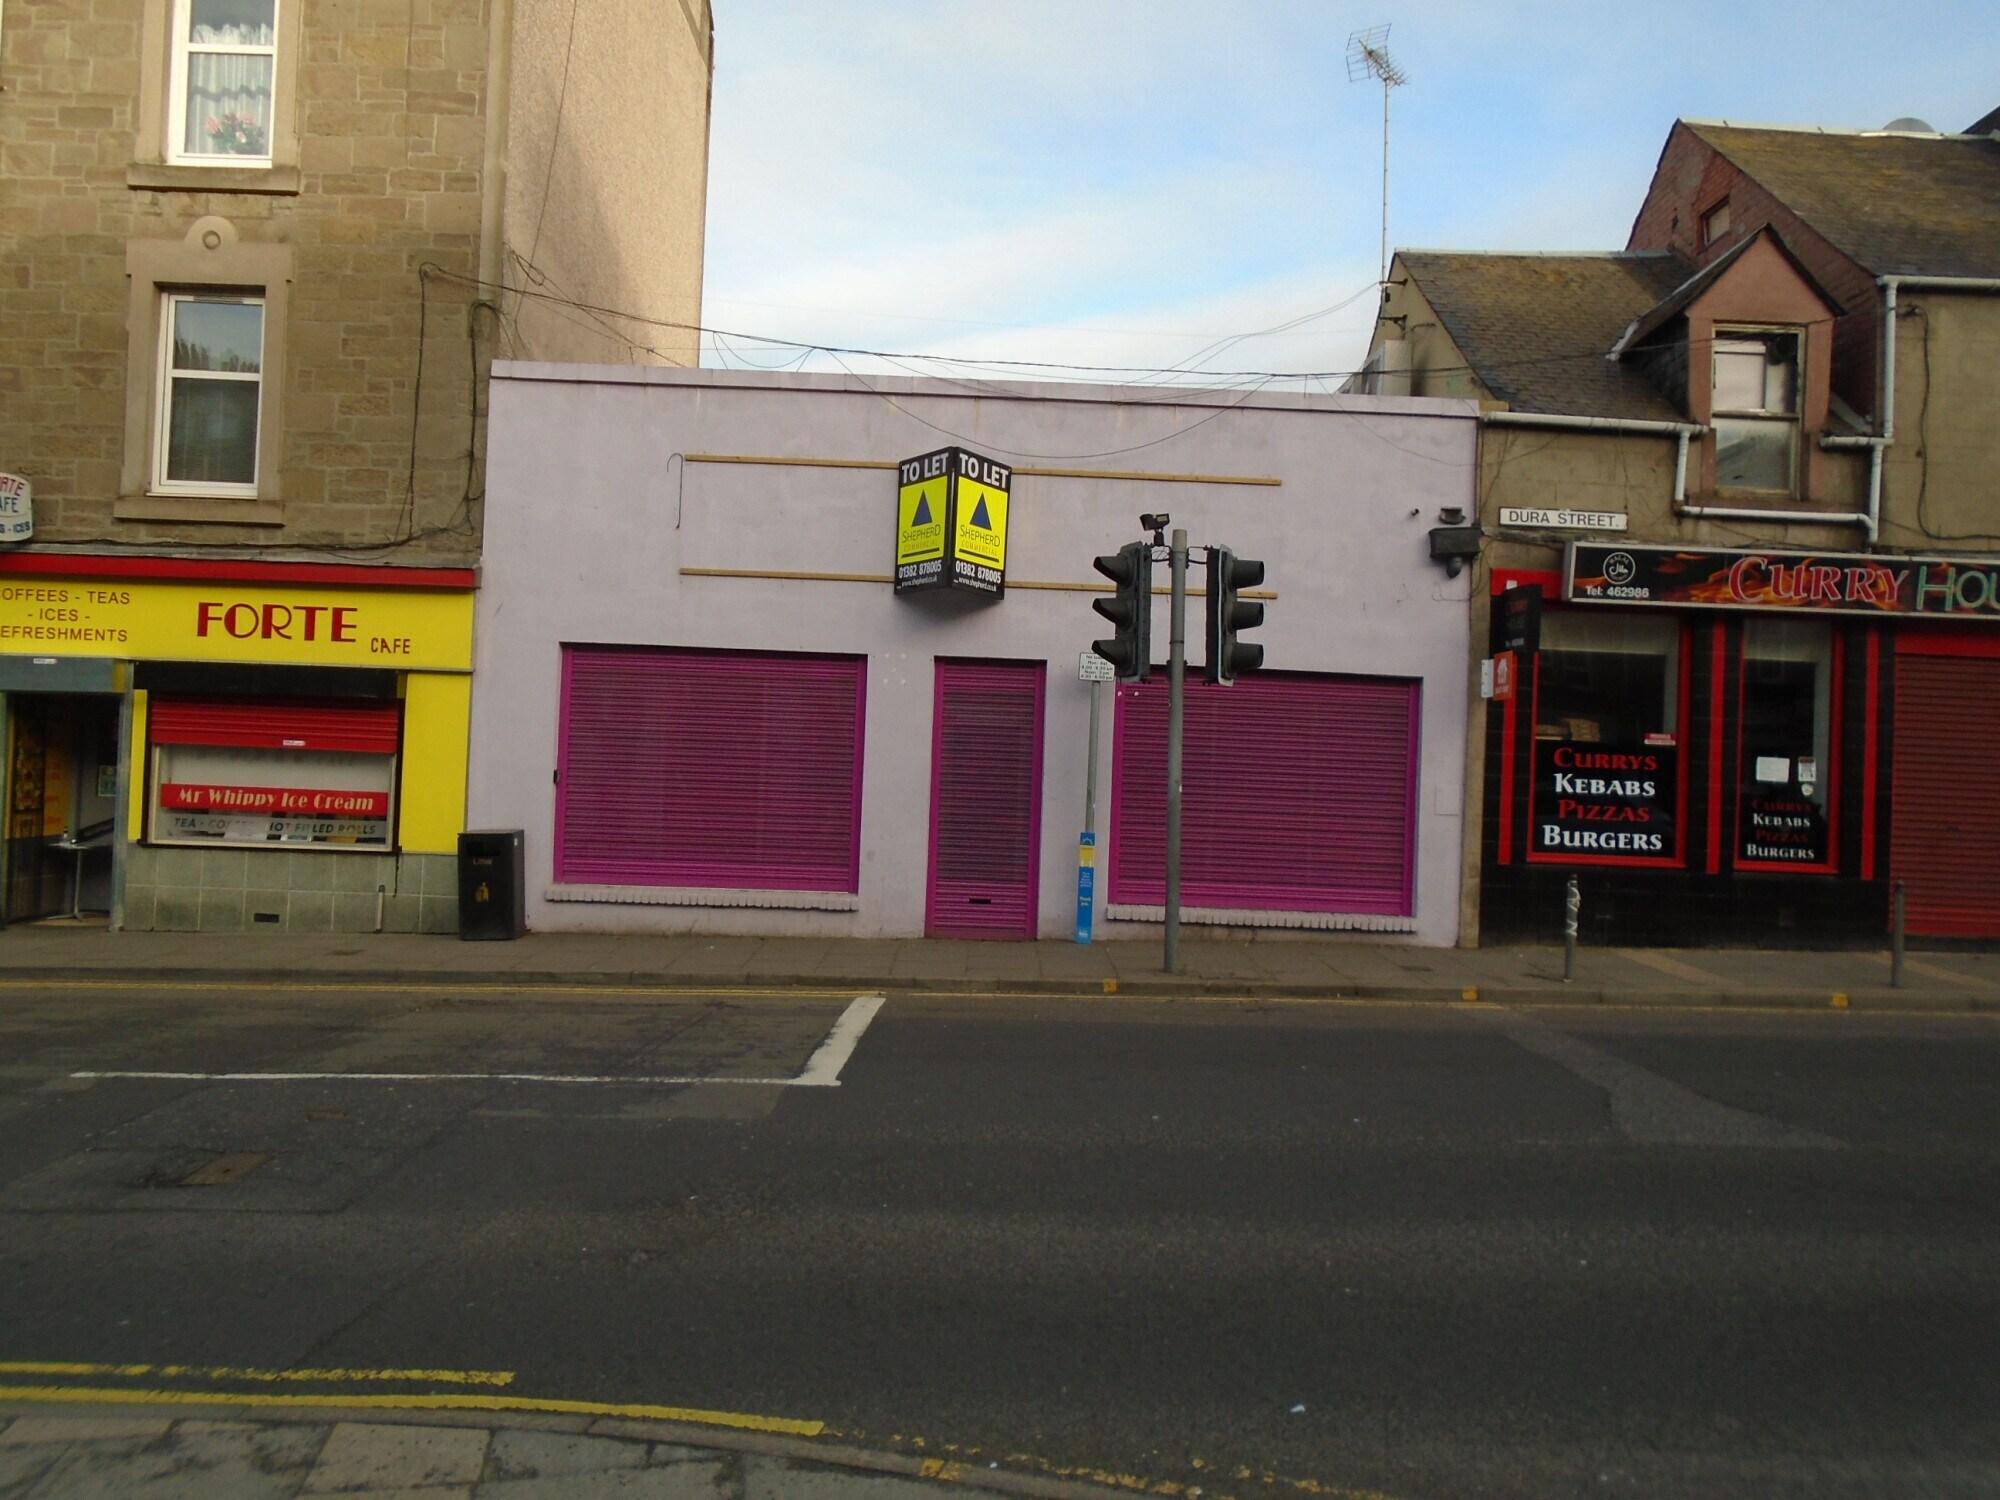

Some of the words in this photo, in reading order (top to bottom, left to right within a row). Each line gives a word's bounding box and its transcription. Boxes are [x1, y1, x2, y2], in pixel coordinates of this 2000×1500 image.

[902, 462, 920, 484] TO
[924, 452, 949, 478] LET
[959, 453, 979, 479] TO
[983, 462, 1009, 489] LET
[0, 476, 25, 497] RTE
[1509, 510, 1550, 524] DURA
[902, 524, 941, 544] SHEPHERD
[960, 524, 1001, 548] SHEPHERD
[899, 564, 917, 579] 01382
[919, 560, 942, 575] 878005
[955, 560, 976, 577] 01382
[977, 567, 1002, 584] 878005
[1606, 586, 1650, 598] 462986
[1728, 556, 1910, 603] CURRY
[1915, 565, 2000, 612] HOU
[0, 587, 68, 602] OFFEES
[87, 590, 130, 605] TEAS
[40, 607, 79, 622] ICES
[0, 625, 128, 642] EFRESHMENTS
[196, 602, 358, 643] FORTE
[370, 637, 410, 654] CAFE
[1553, 747, 1658, 771] CURRYS
[1553, 773, 1656, 797] KEBABS
[179, 787, 204, 803] Mr
[209, 789, 278, 807] Whippy
[281, 792, 308, 808] Ice
[313, 793, 374, 811] Cream
[1558, 799, 1651, 823] PIZZAS
[1753, 813, 1811, 828] KEBABS
[174, 818, 195, 828] TEA
[1542, 824, 1663, 850] BURGERS
[1747, 843, 1815, 859] BURGERS
